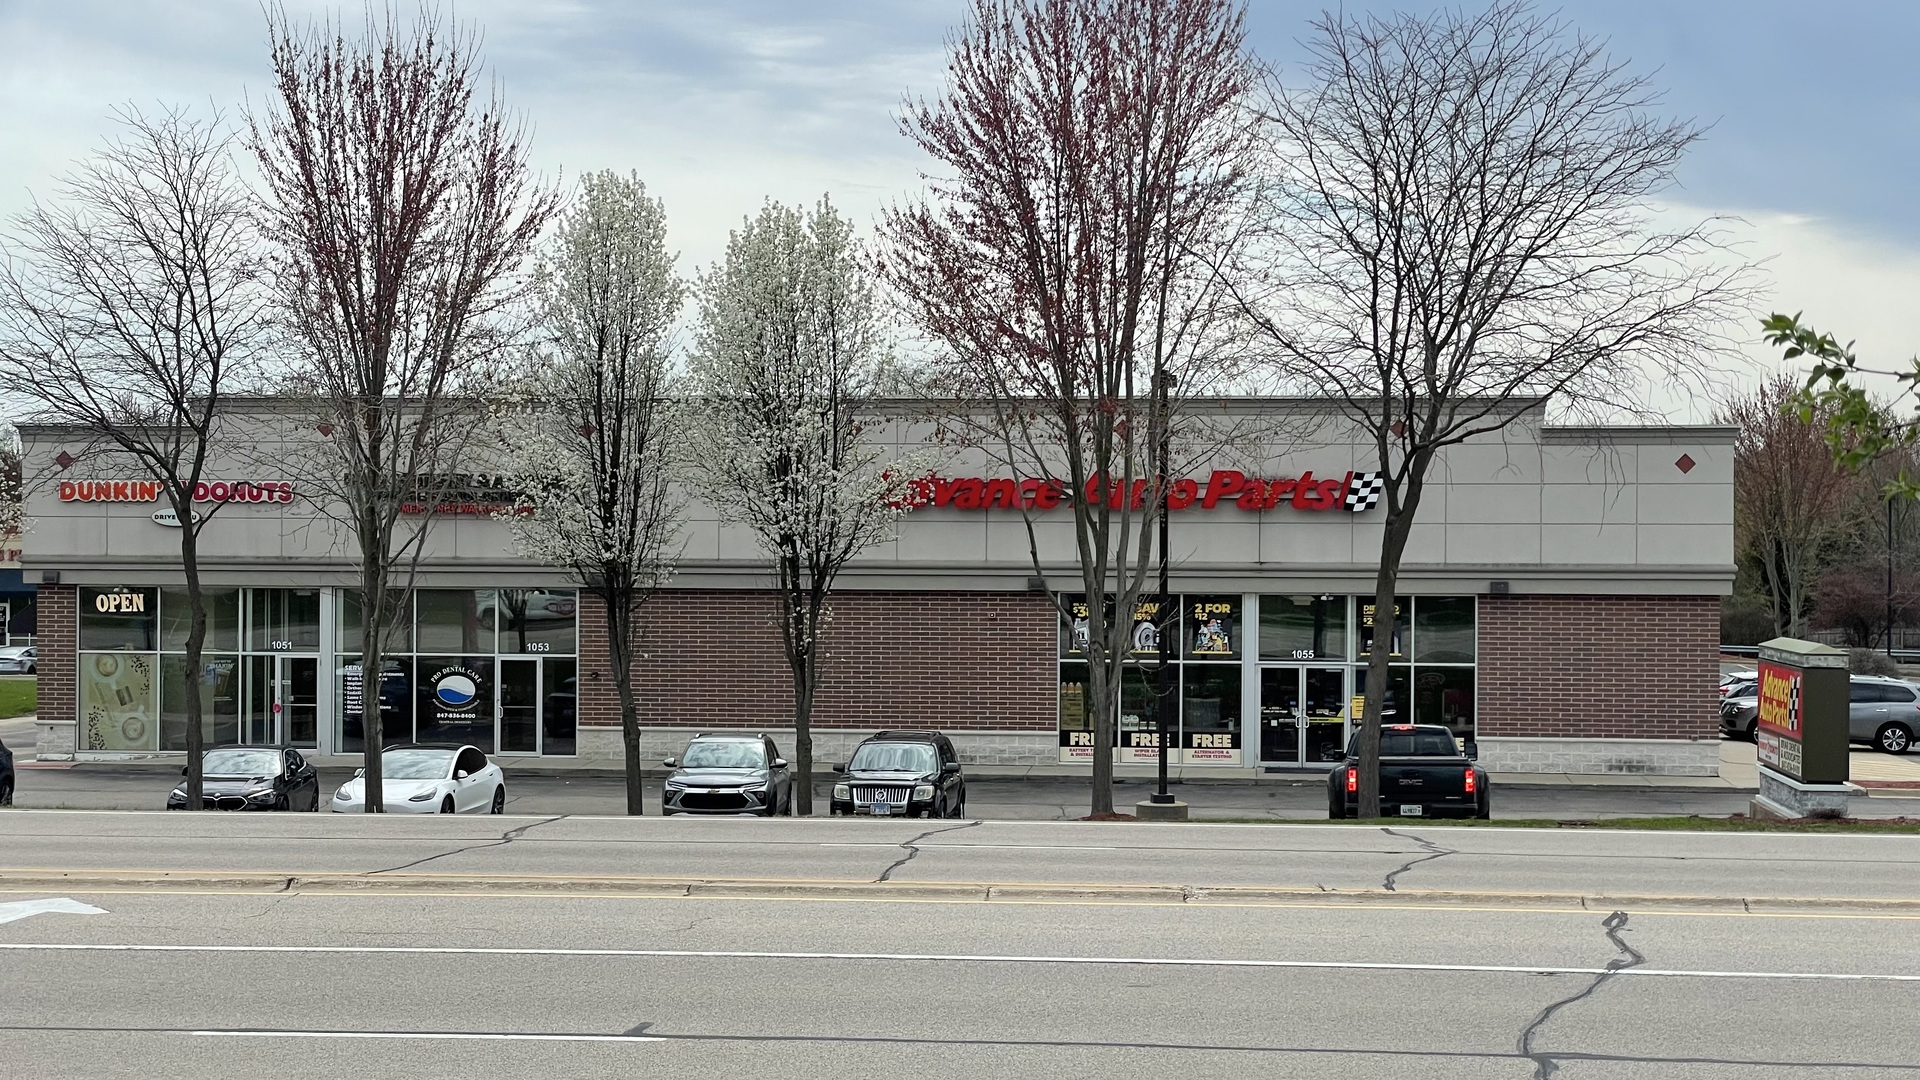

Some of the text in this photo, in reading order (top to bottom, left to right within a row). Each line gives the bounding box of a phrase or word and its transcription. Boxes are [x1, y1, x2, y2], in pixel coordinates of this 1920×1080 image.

[58, 480, 164, 501] DUNKIN'
[882, 469, 1064, 510] dvance
[1202, 470, 1340, 511] Parts
[96, 594, 145, 612] OPEN
[1194, 603, 1231, 613] 2 FOR
[1194, 612, 1208, 620] $12
[271, 641, 292, 650] 1051
[526, 642, 550, 651] 1053
[1291, 649, 1315, 659] 1055
[430, 665, 483, 684] PRO DENTAL CARE
[1762, 669, 1788, 703] Advance
[1760, 696, 1772, 723] Auto
[1069, 732, 1095, 746] FR
[1131, 733, 1170, 747] FRE
[1192, 733, 1232, 748] FREE
